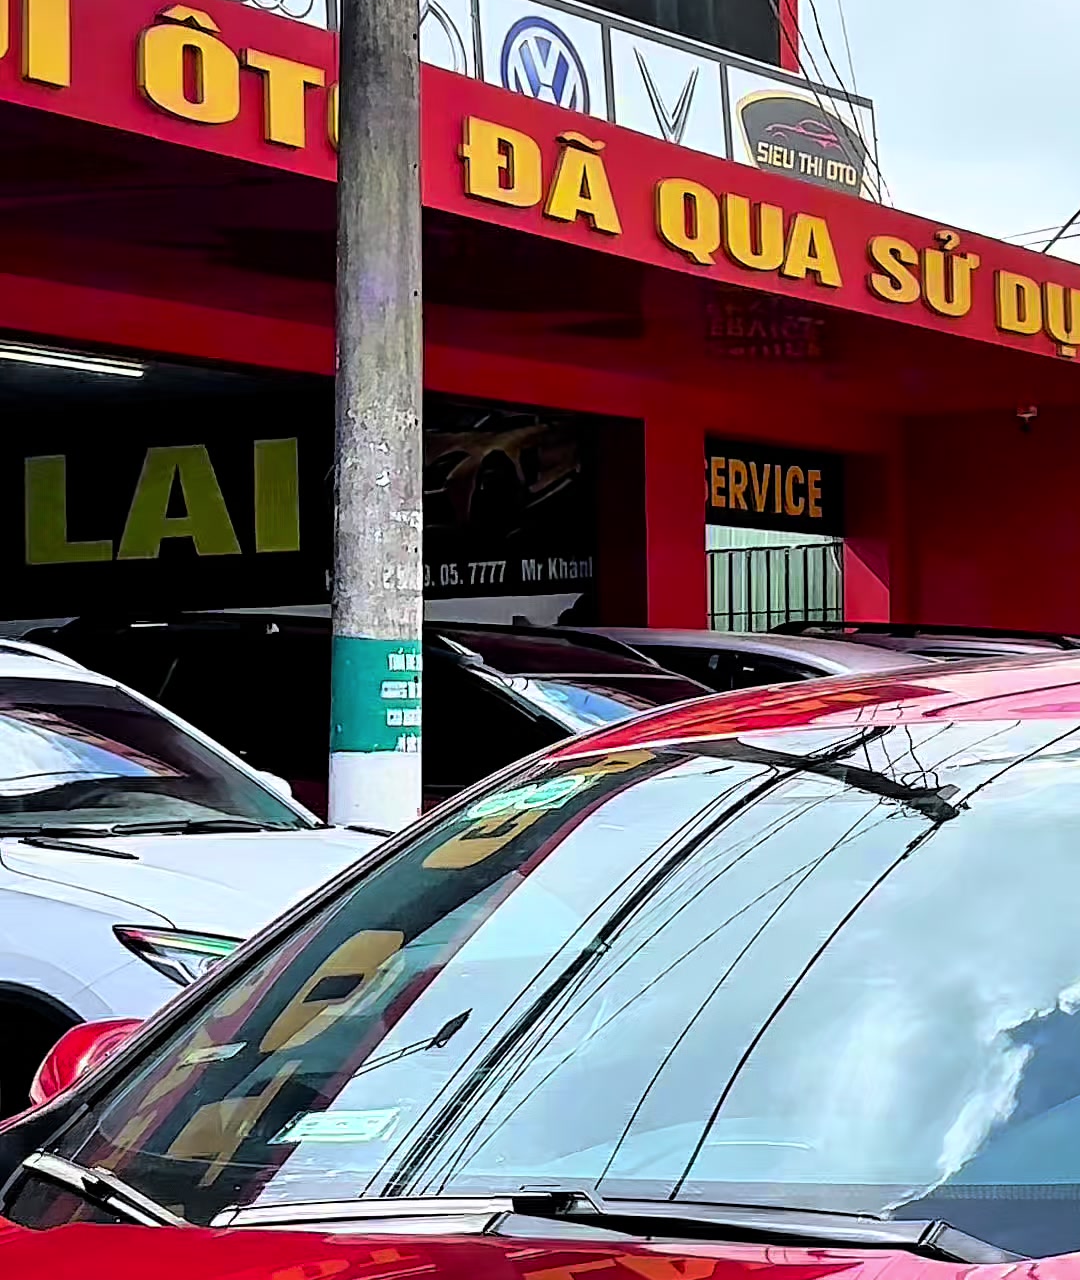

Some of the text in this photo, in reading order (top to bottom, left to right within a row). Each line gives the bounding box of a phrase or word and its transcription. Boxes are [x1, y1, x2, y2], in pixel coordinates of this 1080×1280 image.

[136, 3, 340, 152] ÔT
[459, 115, 623, 235] ĐÃ
[656, 176, 843, 289] QUA
[867, 228, 981, 318] SỬ
[757, 141, 795, 169] SIEU
[799, 152, 823, 177] THI
[25, 437, 301, 565] LAI
[704, 456, 823, 518] ERVICE
[521, 559, 543, 582] Mr
